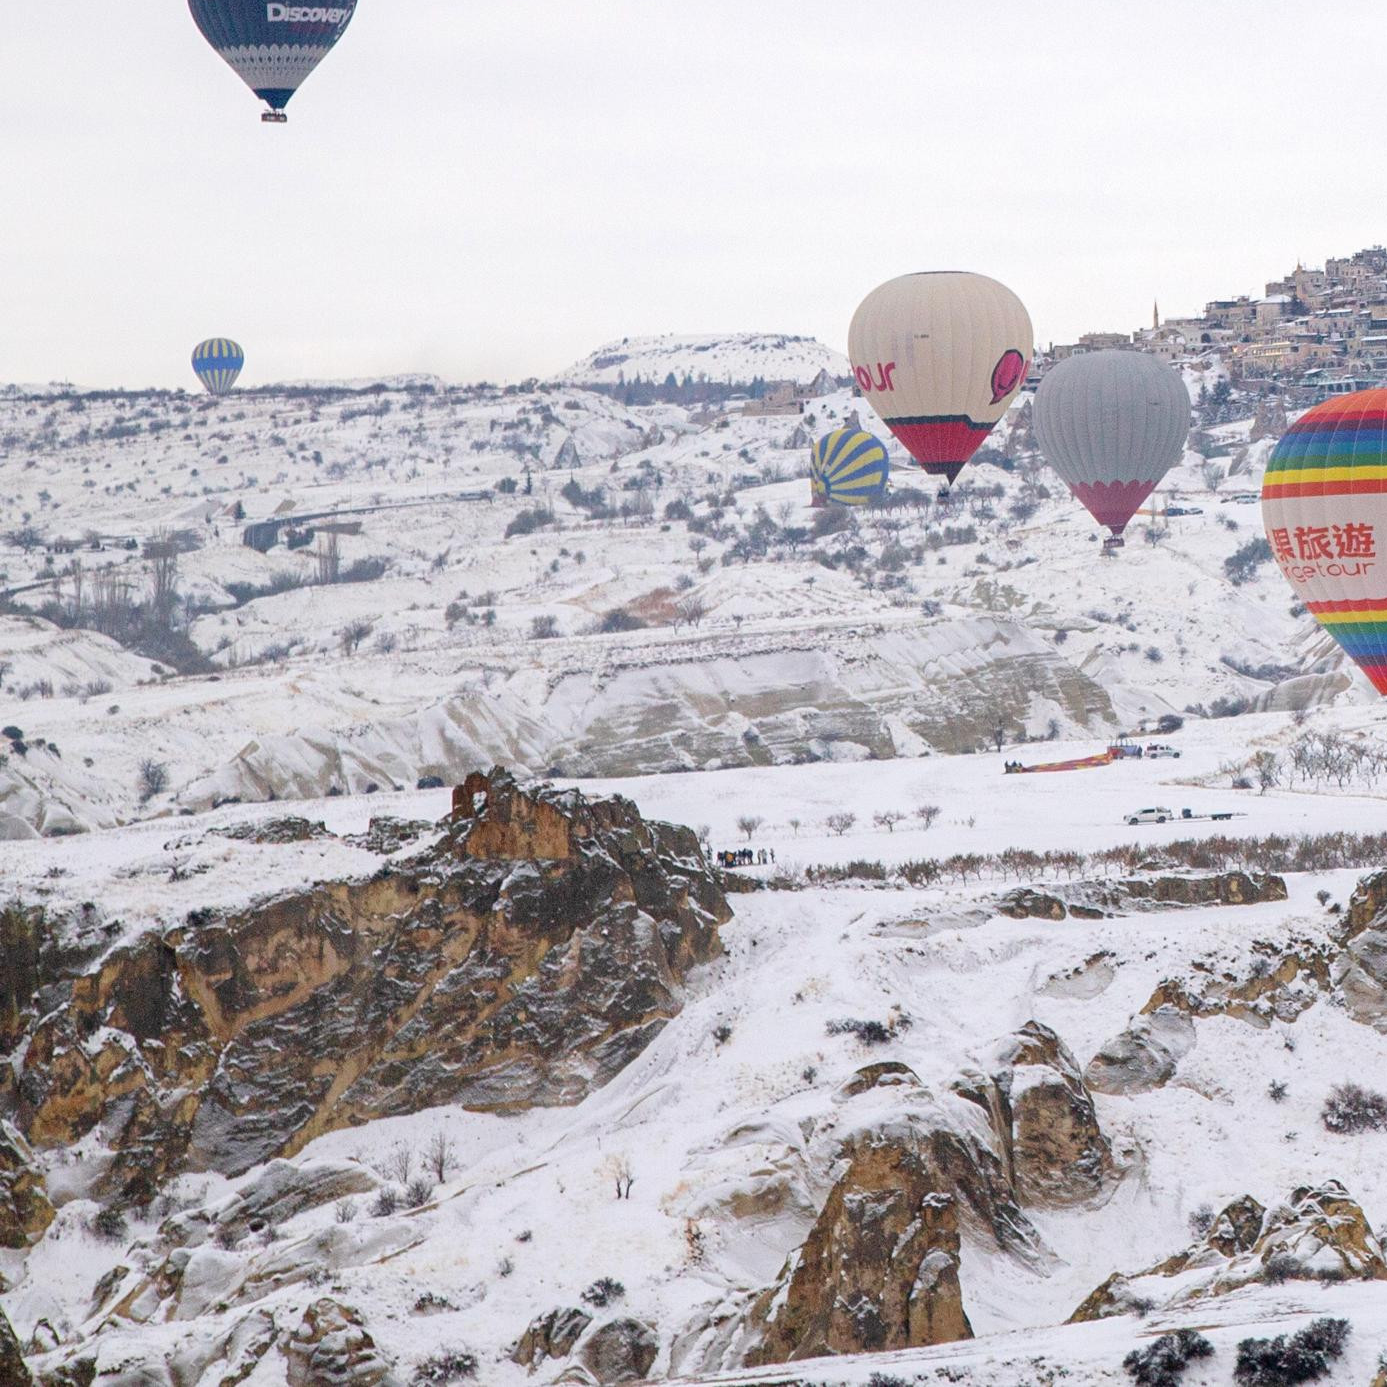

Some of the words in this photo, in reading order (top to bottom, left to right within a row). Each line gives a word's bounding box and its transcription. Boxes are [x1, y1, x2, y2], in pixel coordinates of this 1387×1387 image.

[266, 2, 352, 29] Discovery
[850, 361, 896, 392] our
[1266, 523, 1376, 564] 果旅遊
